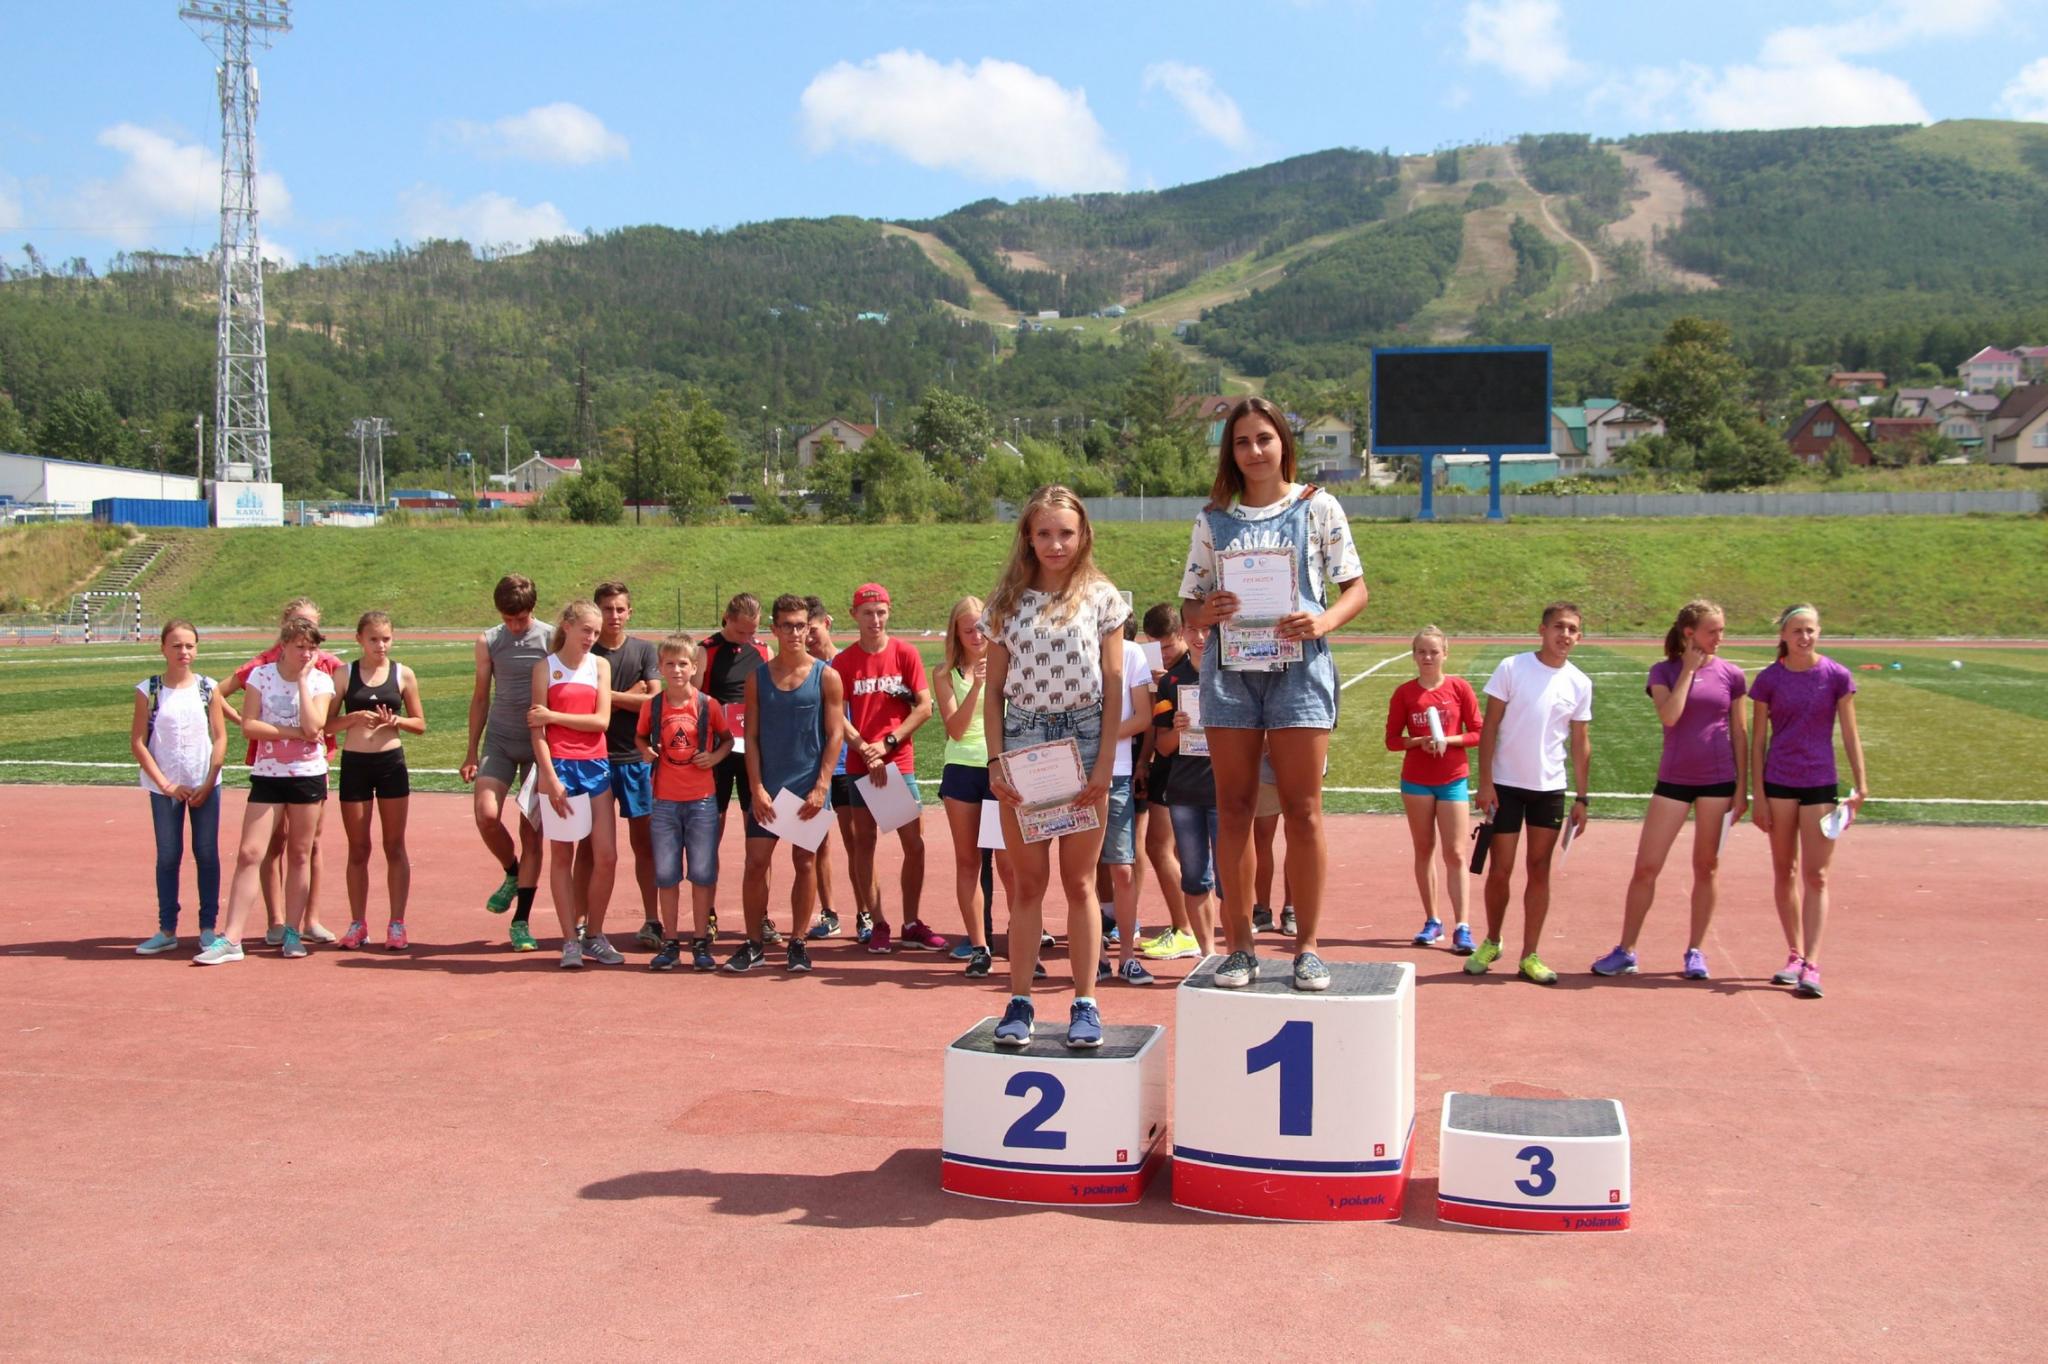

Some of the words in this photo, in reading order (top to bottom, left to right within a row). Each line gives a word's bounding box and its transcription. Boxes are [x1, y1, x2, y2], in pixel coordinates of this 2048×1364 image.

[1246, 1020, 1314, 1136] 1
[1003, 1071, 1067, 1150] 2
[1514, 1146, 1556, 1197] 3
[1083, 1183, 1128, 1196] polanik
[1339, 1194, 1385, 1208] polanik
[1575, 1216, 1622, 1229] polanik
